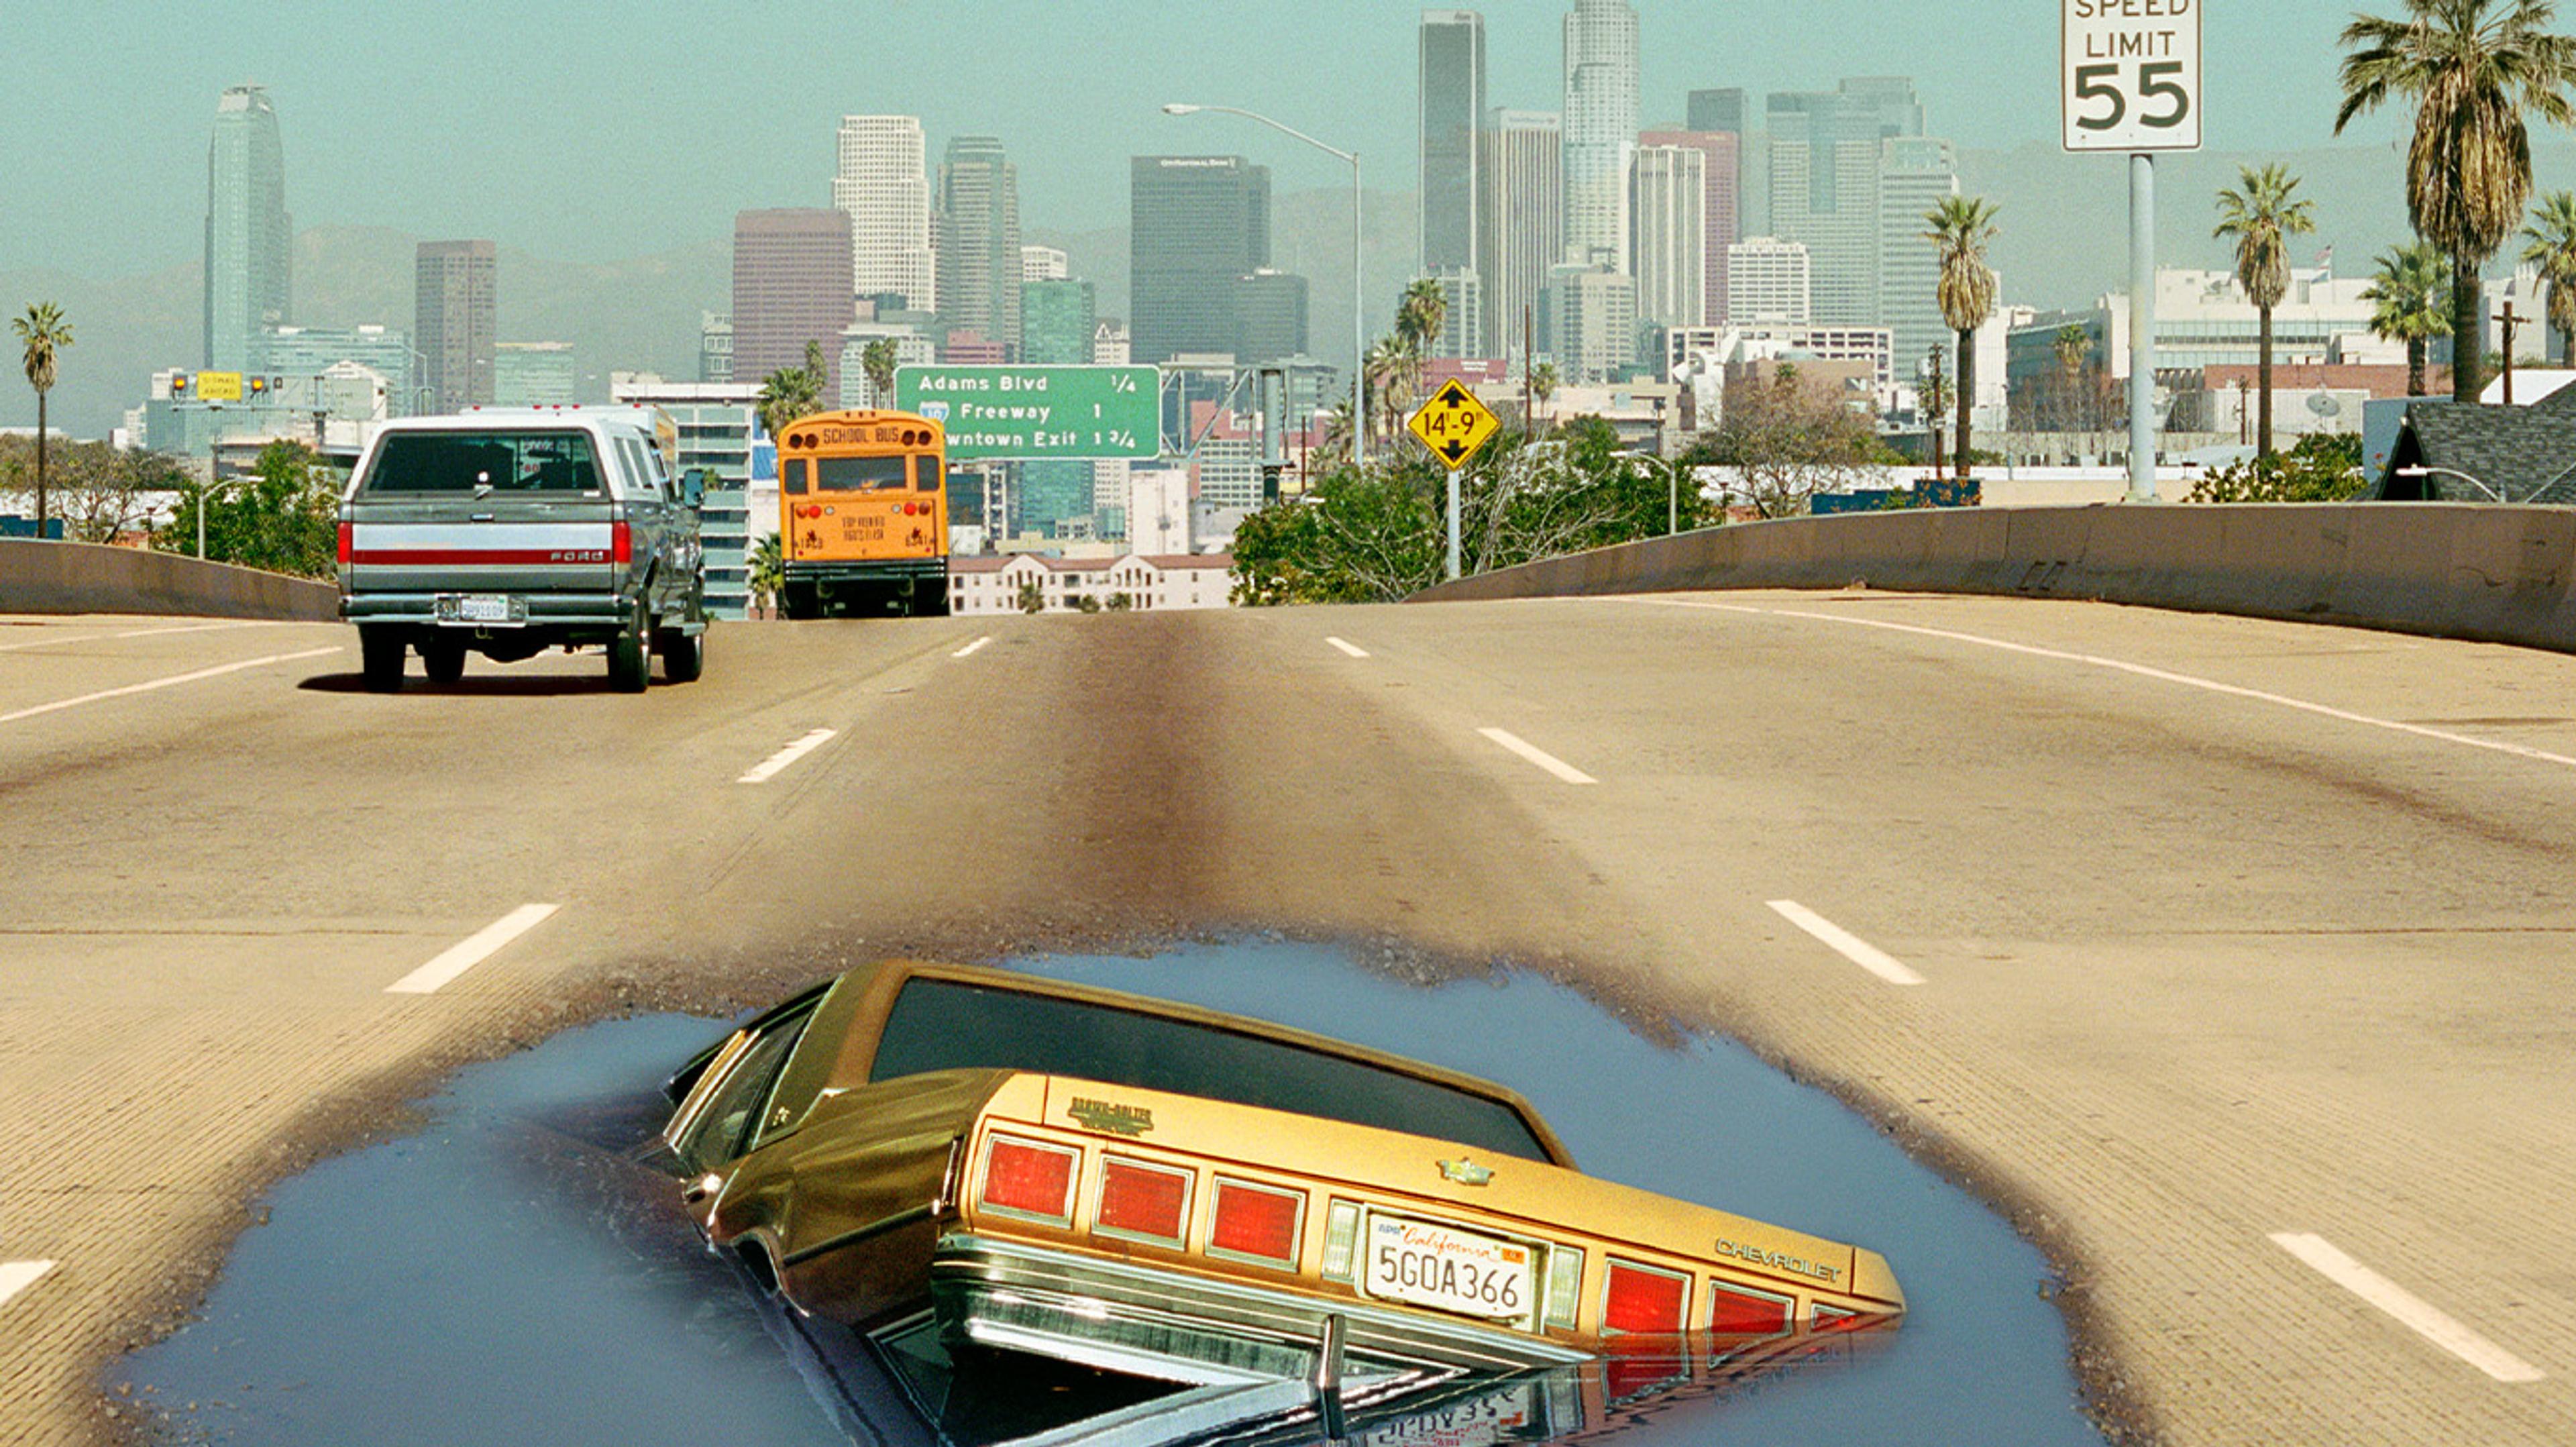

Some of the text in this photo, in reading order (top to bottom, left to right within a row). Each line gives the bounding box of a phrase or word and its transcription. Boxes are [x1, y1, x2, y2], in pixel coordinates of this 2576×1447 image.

[2076, 0, 2188, 17] SPEED
[2086, 31, 2176, 58] LIMIT
[2076, 61, 2189, 130] 55
[918, 374, 1136, 394] Adams Blvd 1/4
[961, 403, 1051, 424] Freeway
[1093, 403, 1102, 419] 1
[823, 426, 899, 445] SCHOOL BUS
[945, 429, 1136, 449] wntown Exit 1 3/4
[550, 551, 604, 561] FORD
[1403, 1227, 1499, 1263] California
[1715, 1237, 1842, 1283] CHEVROLET
